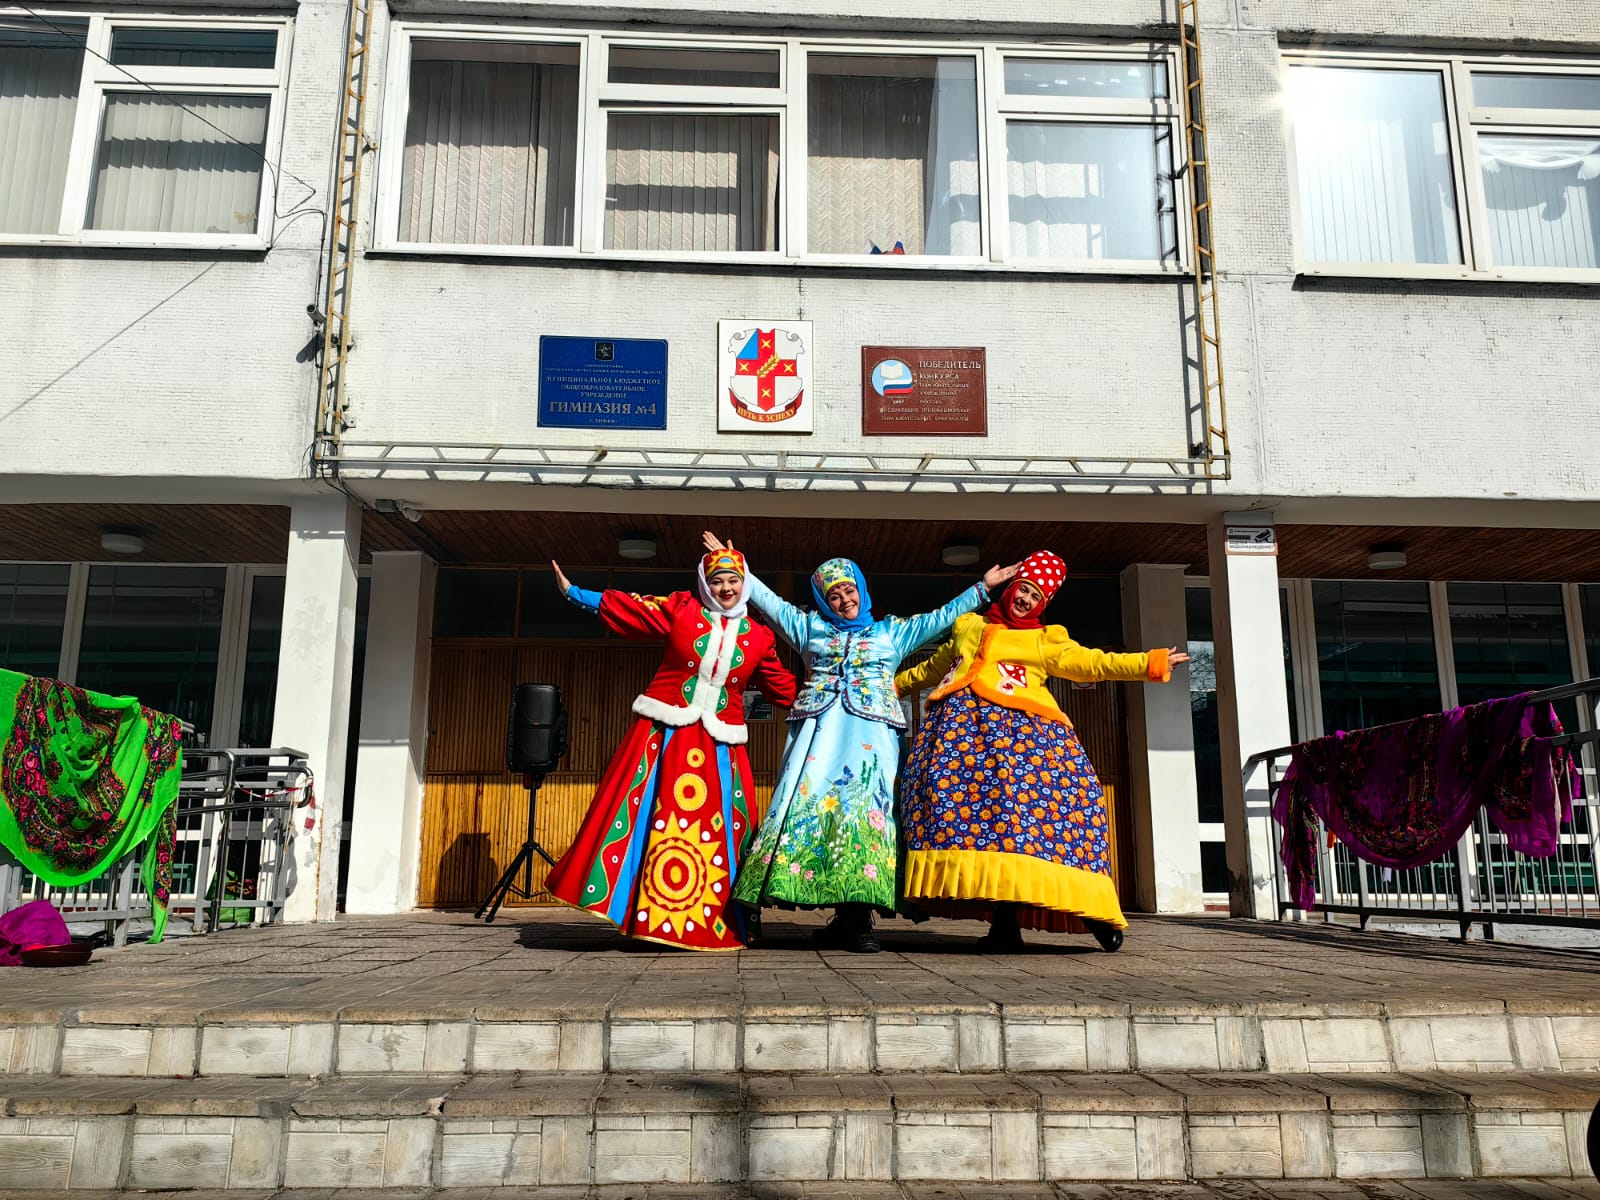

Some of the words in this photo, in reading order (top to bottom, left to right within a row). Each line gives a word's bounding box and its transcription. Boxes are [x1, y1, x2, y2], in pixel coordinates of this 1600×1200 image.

[919, 360, 981, 369] ПОБЕДИТЕЛЬ
[545, 375, 612, 384] МУНИЦИПАЛЬНОЕ
[560, 384, 646, 392] ОБЩЕОБРАЗОВАТЕЛЬНОЕ
[580, 391, 627, 399] УЧРЕЖДЕНИЕ
[549, 401, 632, 415] ГИМНАЗИЯ
[635, 403, 657, 415] №4
[737, 407, 757, 421] ПУТЬ
[766, 407, 796, 421] УСПЕХУ
